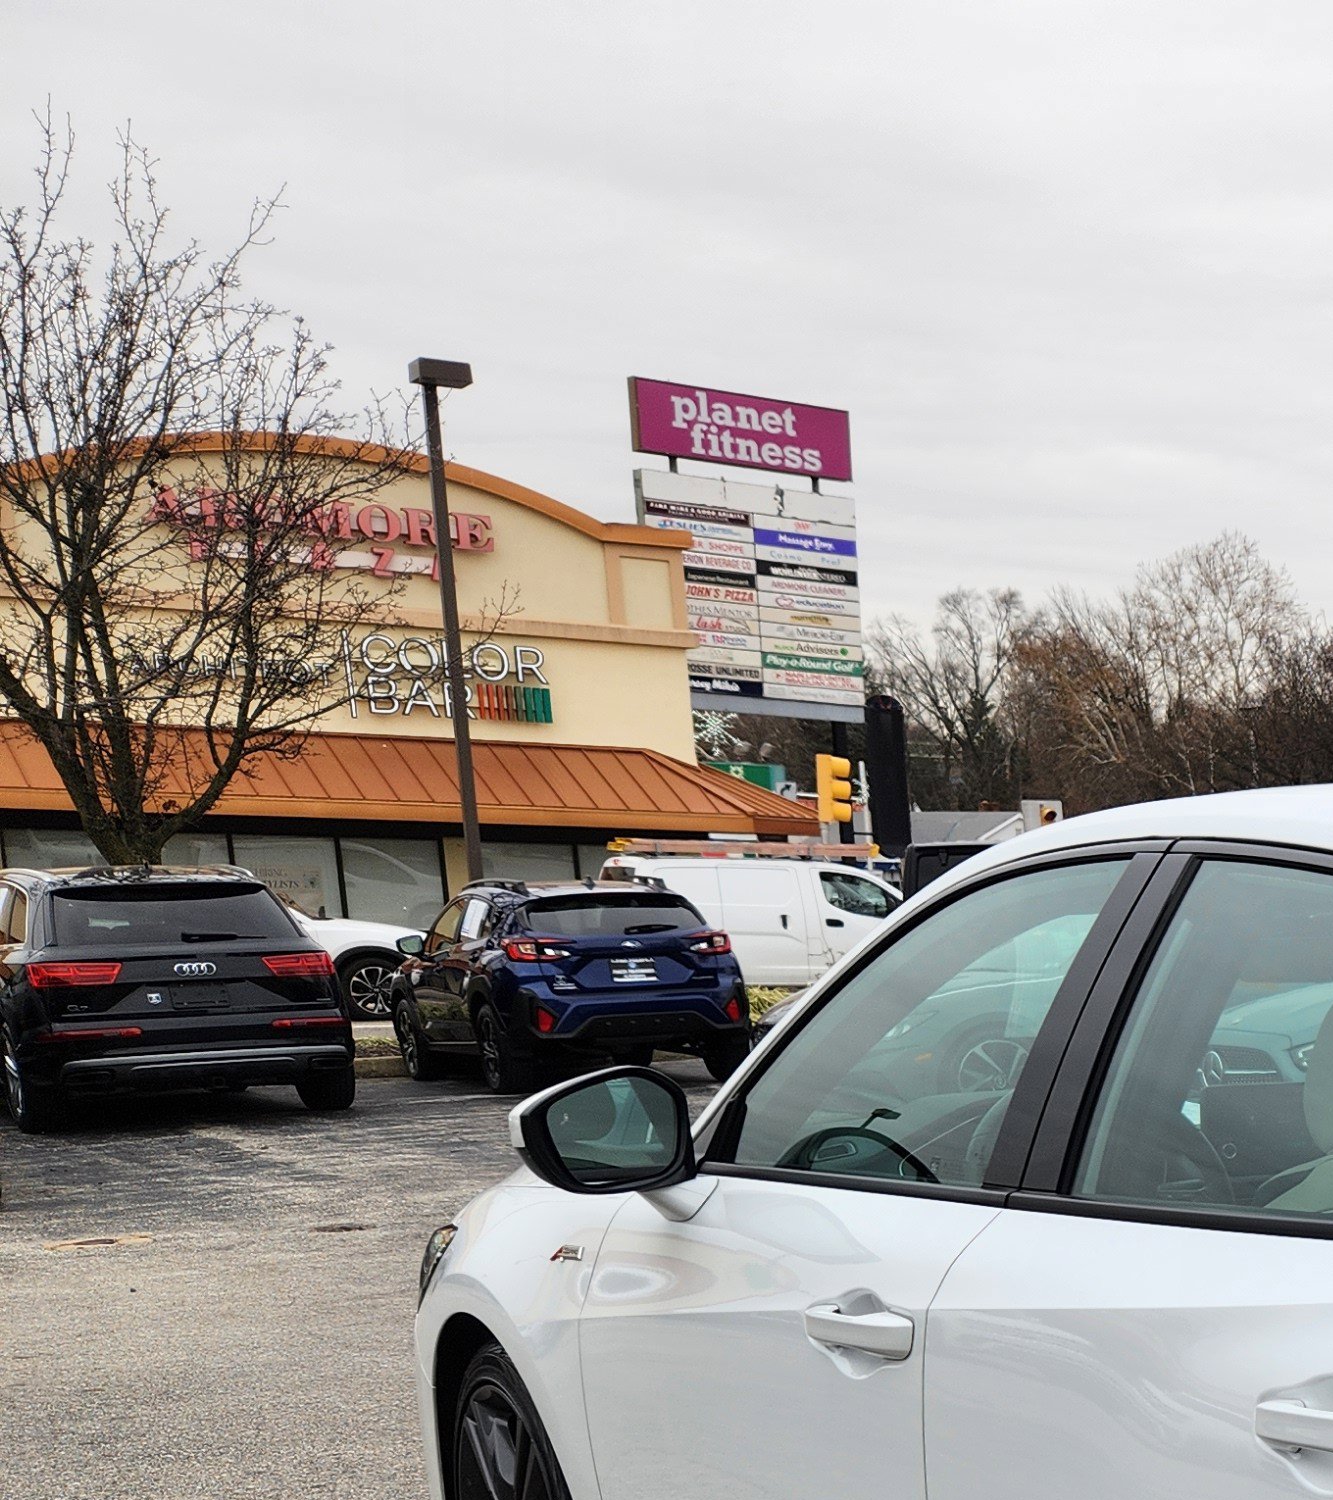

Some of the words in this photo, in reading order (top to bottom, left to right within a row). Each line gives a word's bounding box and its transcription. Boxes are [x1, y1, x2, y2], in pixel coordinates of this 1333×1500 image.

[671, 390, 797, 437] planet
[690, 423, 823, 473] fitness
[708, 542, 744, 554] SHOPPE
[705, 557, 740, 569] BEVERAGE
[686, 585, 721, 598] JOHN'S
[724, 590, 754, 603] PIZZA
[361, 634, 547, 685] COLOR
[715, 665, 760, 679] UNLIMITED
[368, 675, 476, 719] BAR
[66, 1004, 89, 1013] Q7
